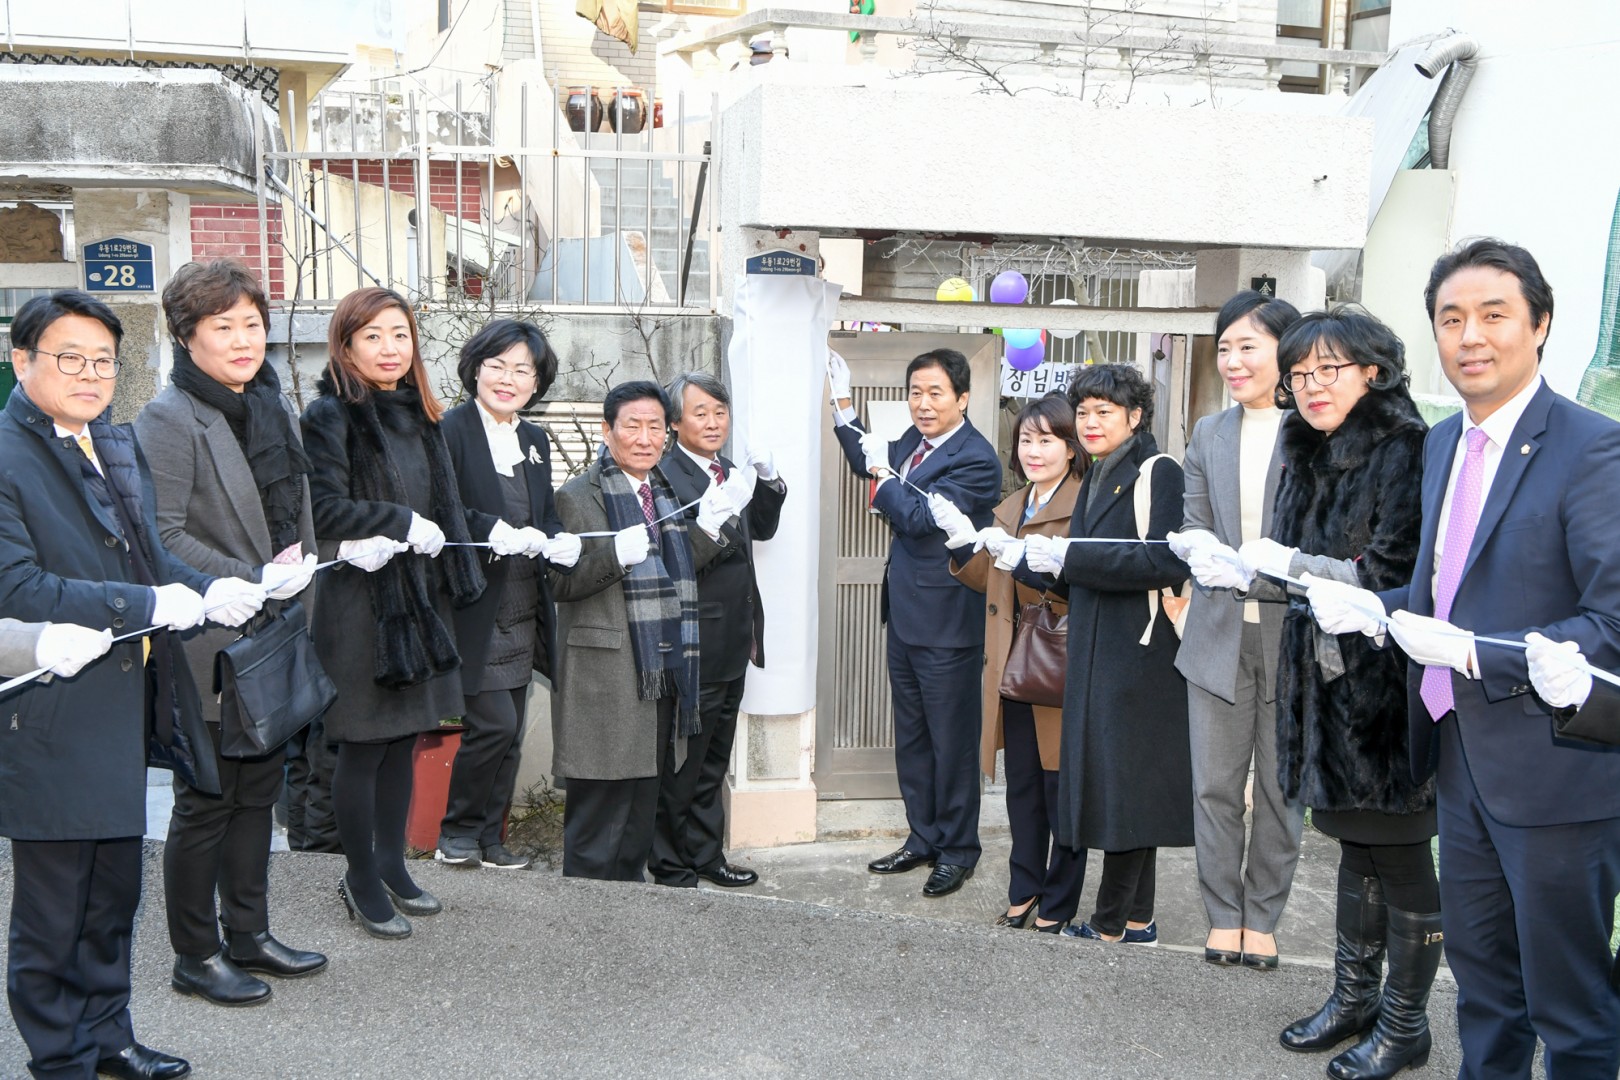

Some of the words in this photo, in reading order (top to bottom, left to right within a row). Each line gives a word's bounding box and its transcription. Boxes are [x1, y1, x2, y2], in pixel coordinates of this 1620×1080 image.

[99, 244, 138, 254] 우동1로29번길
[761, 256, 801, 267] 우동1로29번길
[104, 265, 136, 287] 28
[1001, 366, 1069, 393] 장님방
